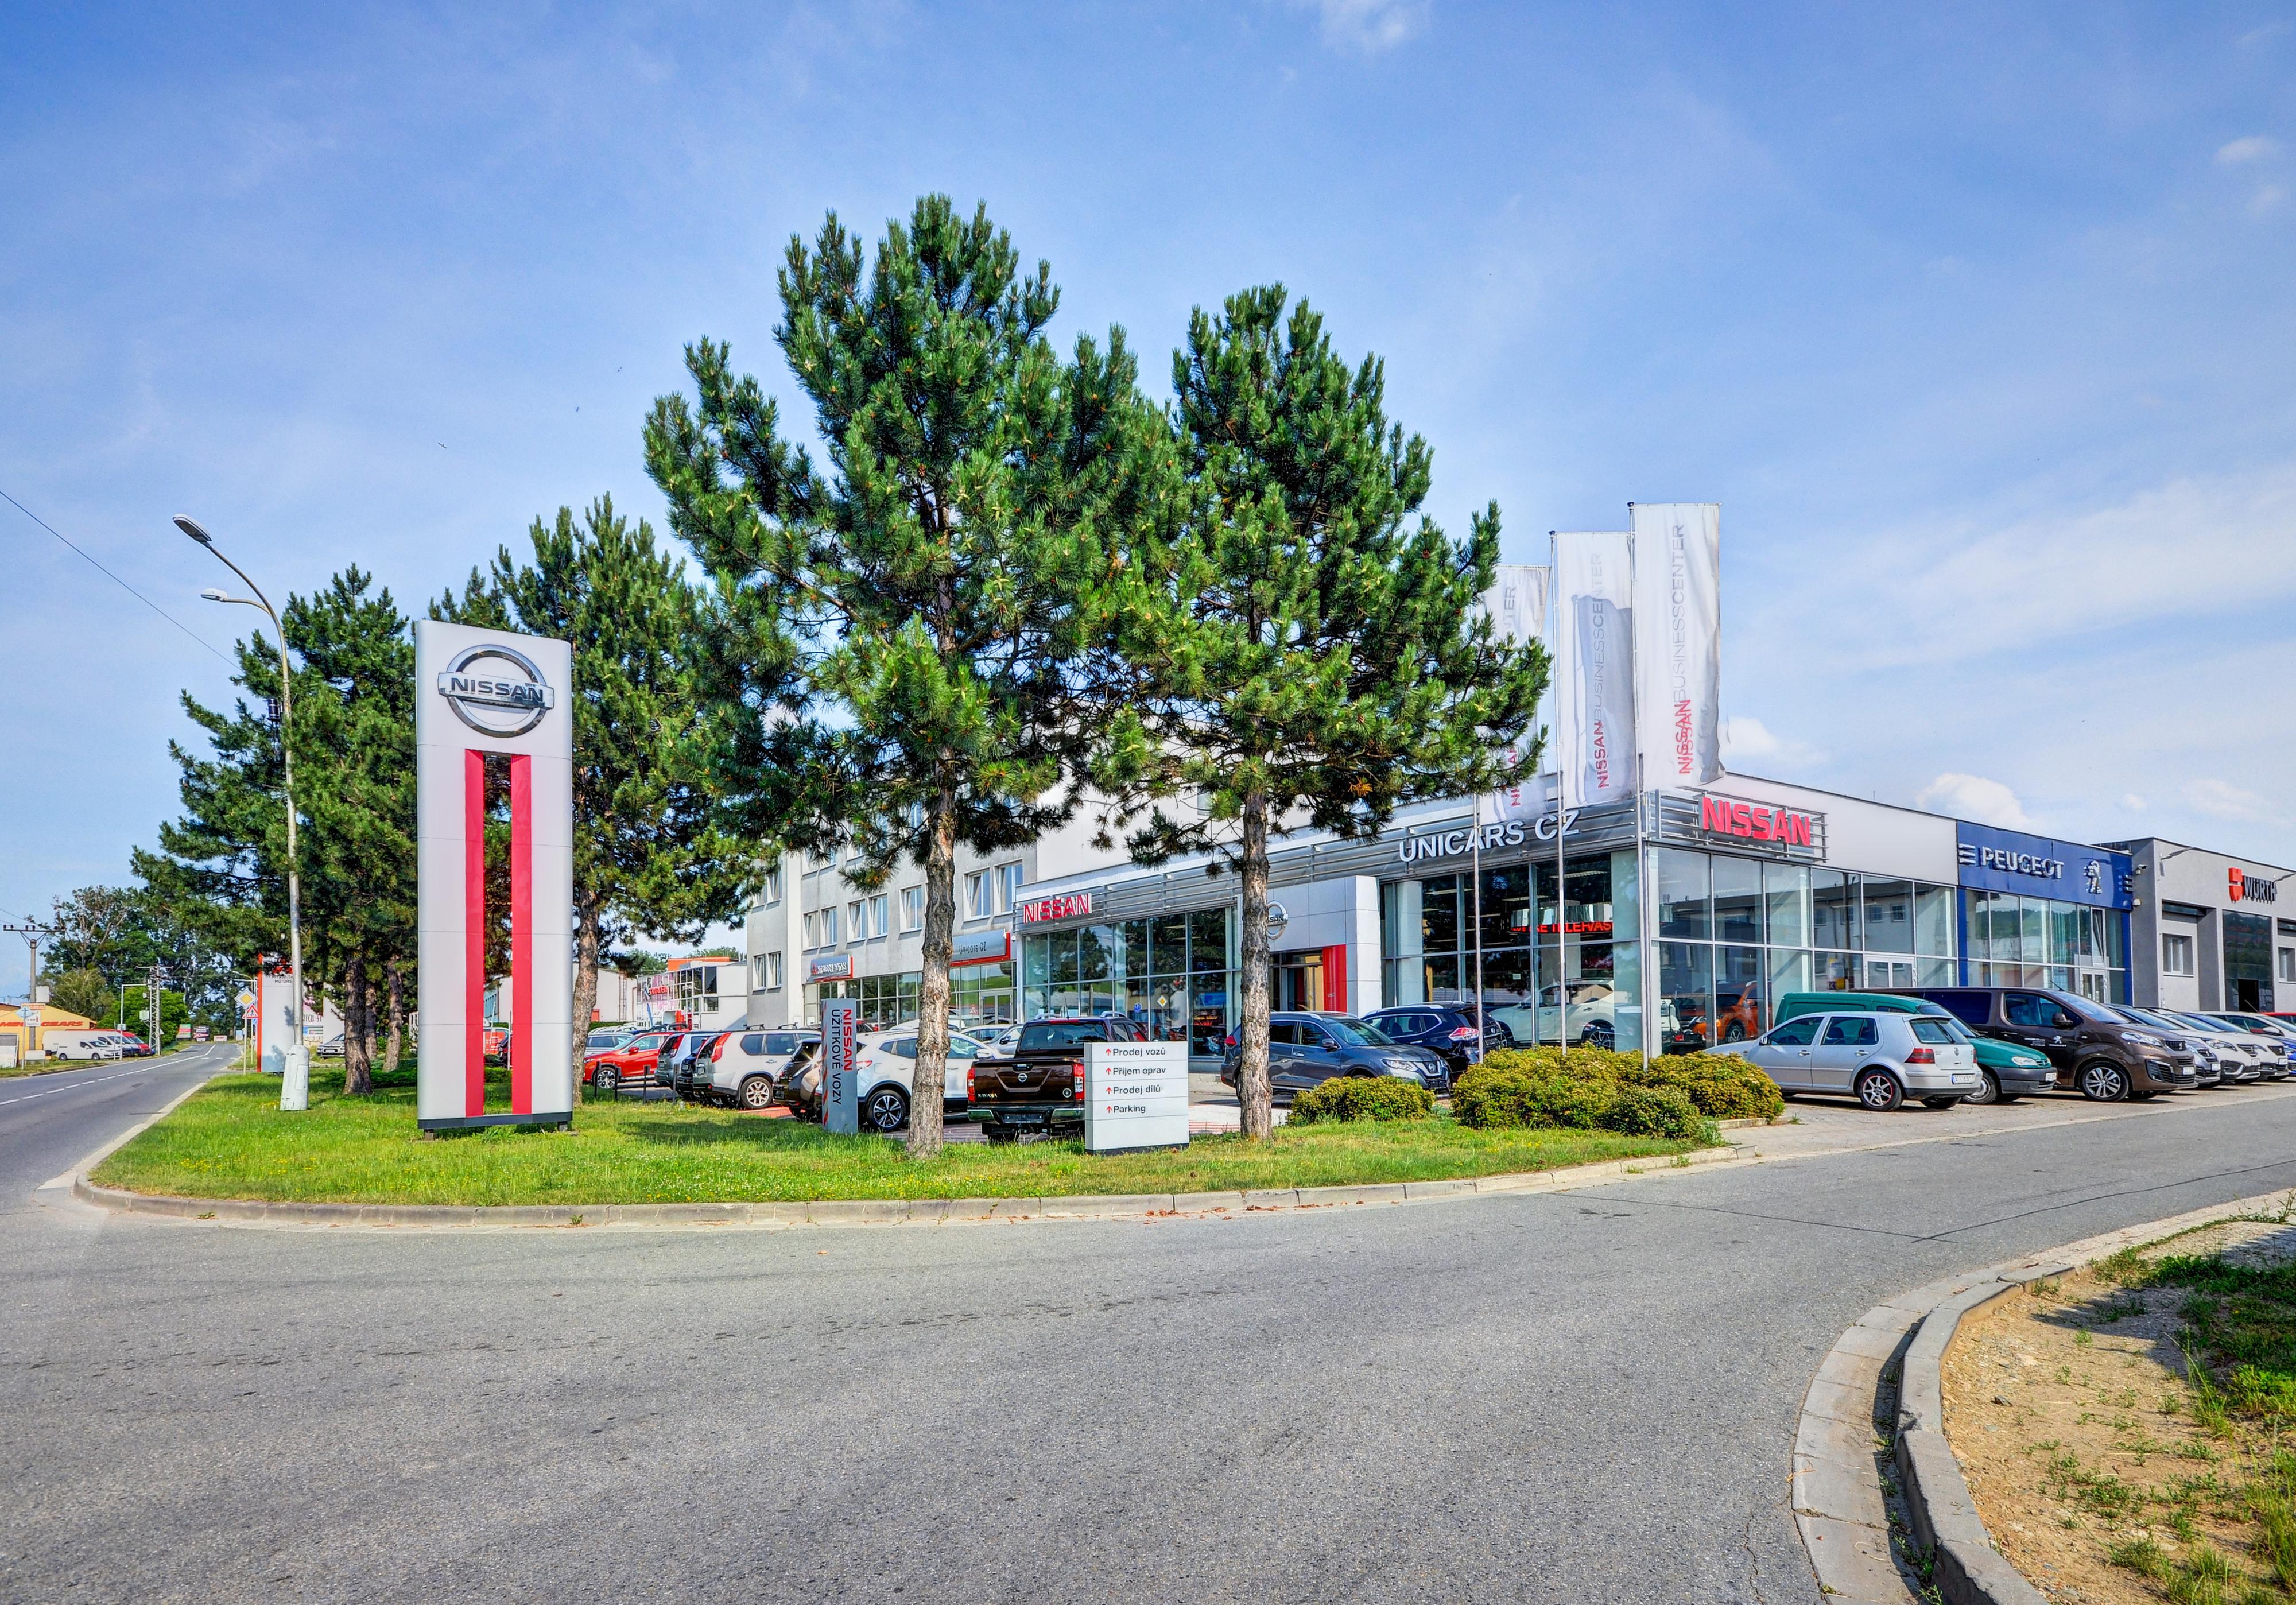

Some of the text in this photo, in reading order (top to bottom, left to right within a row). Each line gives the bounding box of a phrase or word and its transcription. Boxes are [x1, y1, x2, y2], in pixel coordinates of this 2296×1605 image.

[451, 677, 544, 702] NISSAN
[1702, 796, 1810, 846] NISSAN
[1399, 810, 1580, 862] UNICARS CZ
[1982, 846, 2065, 879] PEUGEOT
[2244, 876, 2277, 902] WÜRTH
[1023, 893, 1092, 923] NISSAN
[843, 1009, 852, 1071] NISSAN
[1113, 1047, 1166, 1057] Prodej vozů
[831, 1009, 843, 1105] ÚŽITKOVÉ VOZY
[1113, 1067, 1166, 1076] Příjem oprav
[1113, 1084, 1161, 1095] Prodej dílů
[1114, 1105, 1146, 1114] Parking
